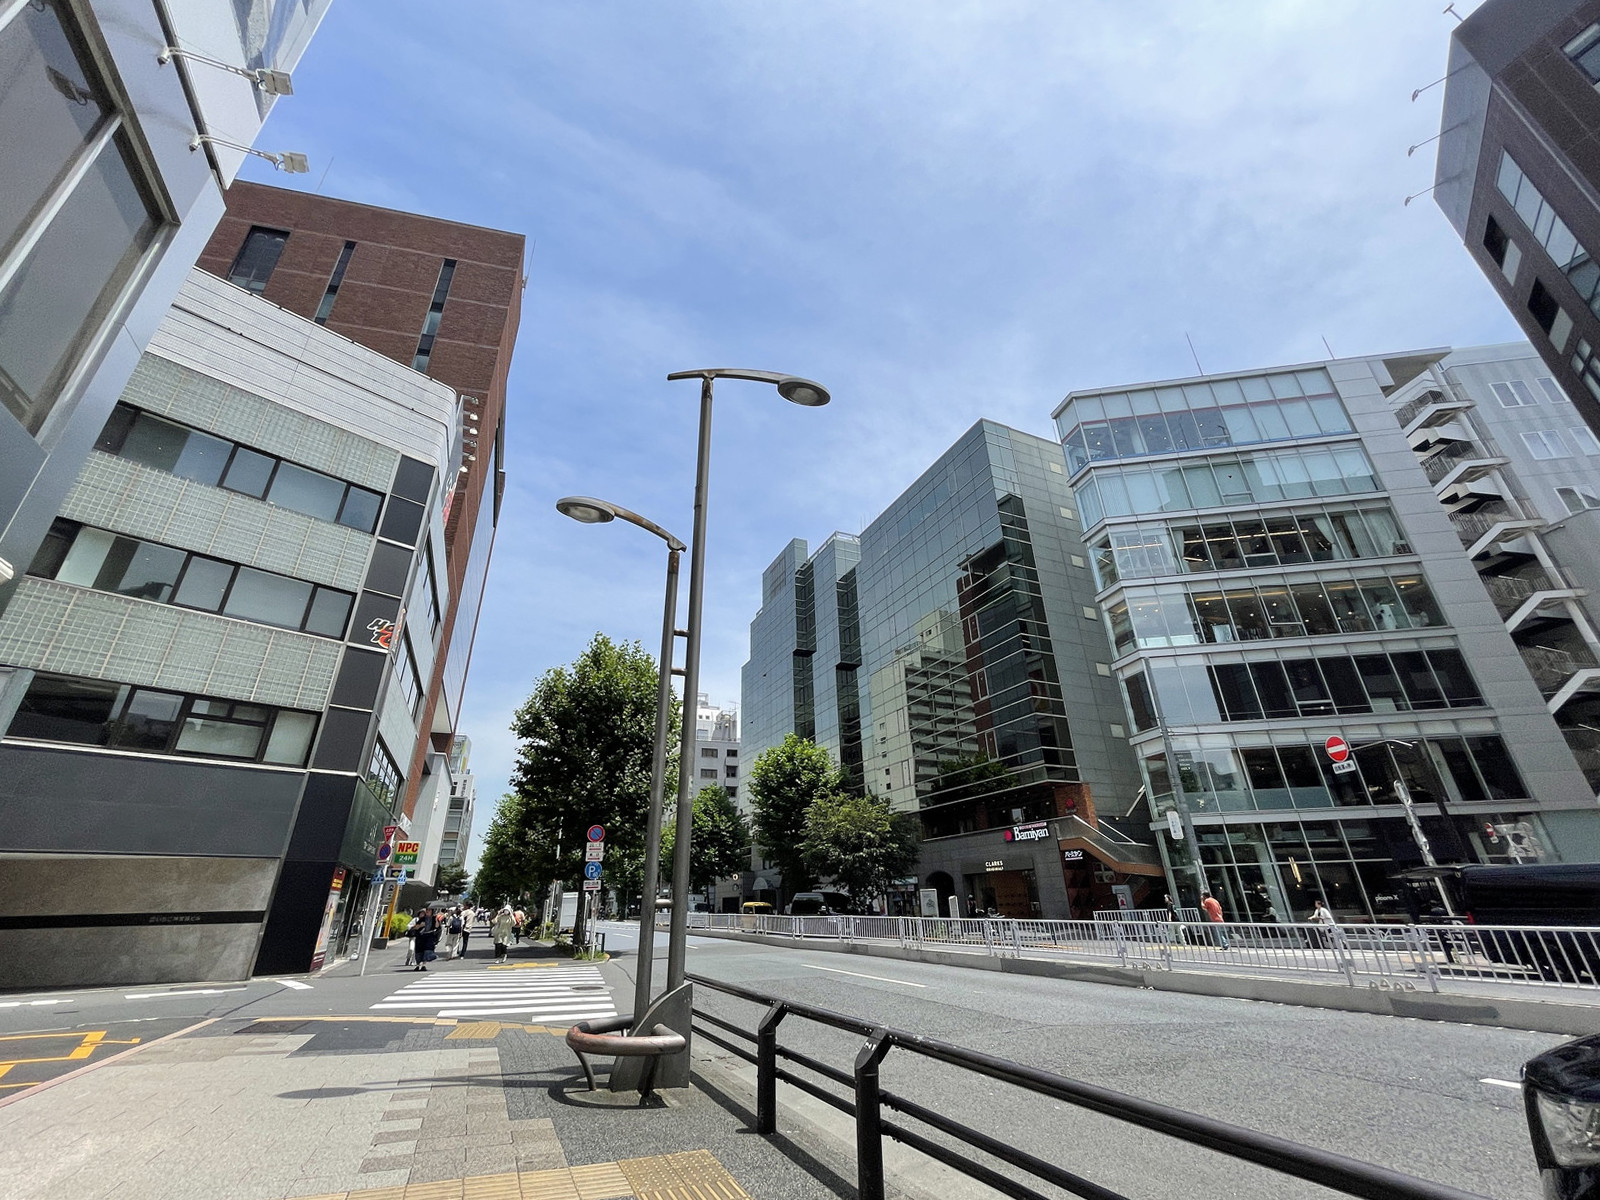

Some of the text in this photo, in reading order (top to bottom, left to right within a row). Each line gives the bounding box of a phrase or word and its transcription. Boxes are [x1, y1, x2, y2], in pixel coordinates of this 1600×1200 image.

[1014, 826, 1048, 840] Bamiyan
[398, 842, 418, 852] NPC
[588, 866, 596, 876] P
